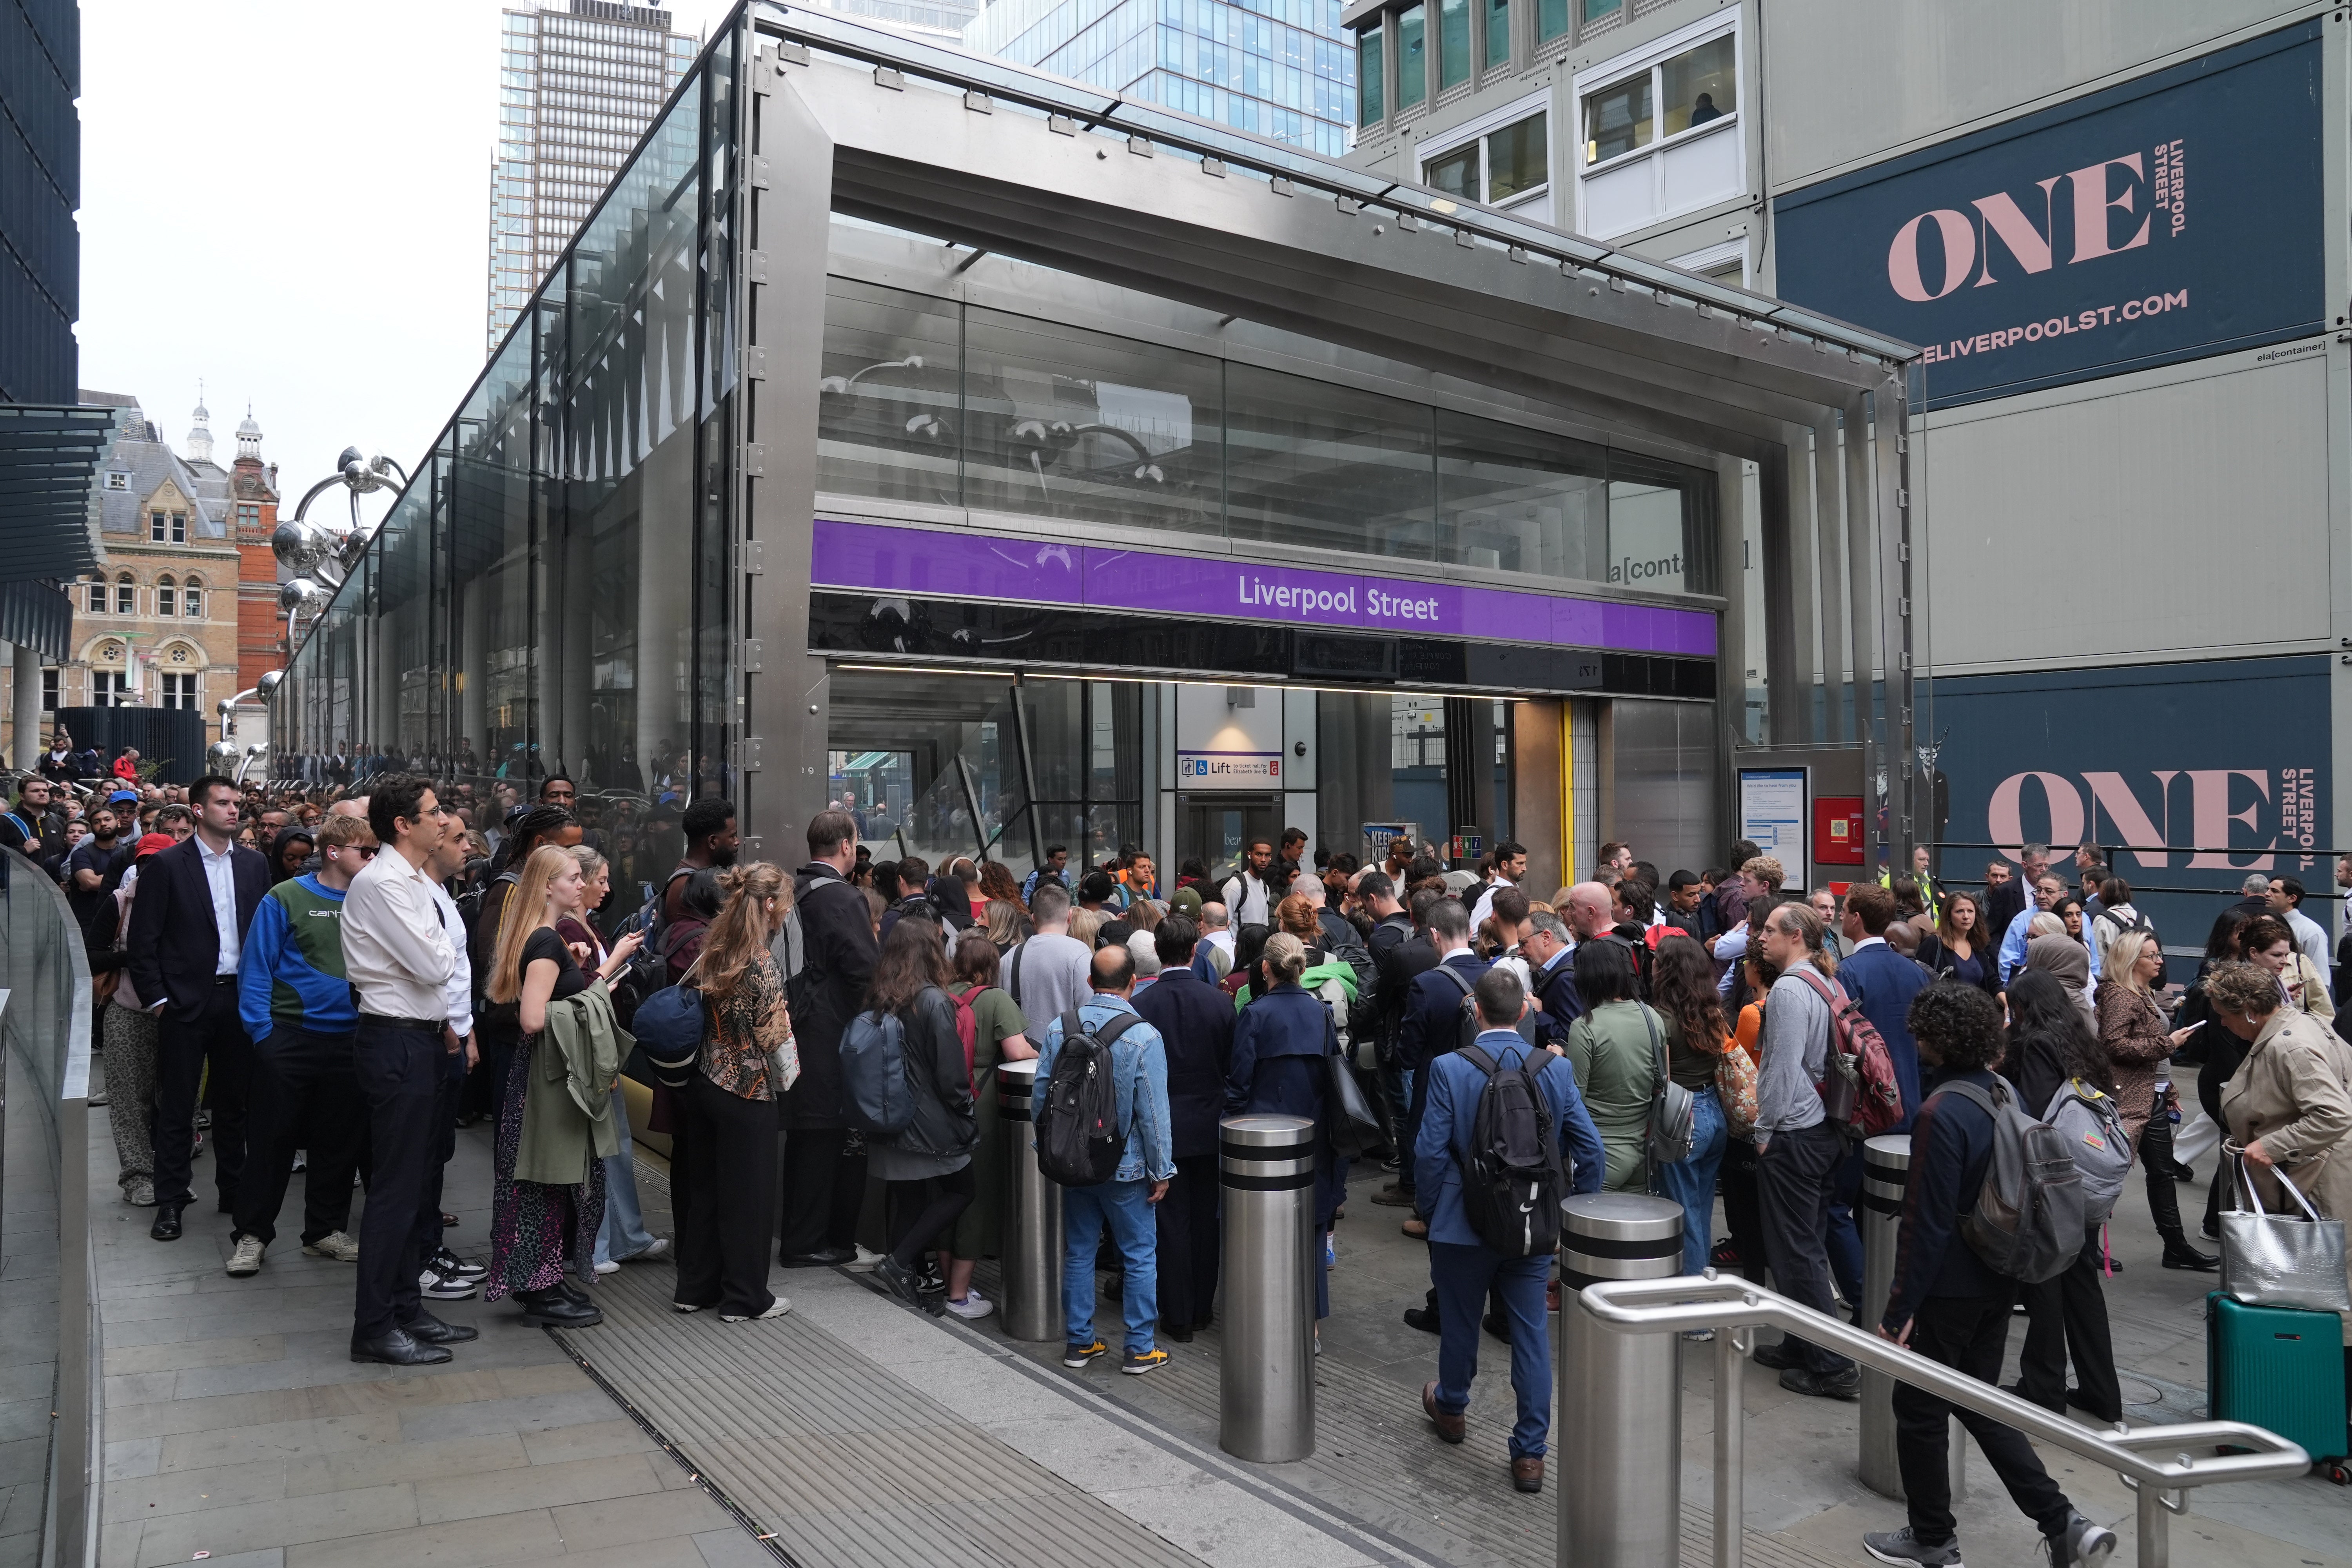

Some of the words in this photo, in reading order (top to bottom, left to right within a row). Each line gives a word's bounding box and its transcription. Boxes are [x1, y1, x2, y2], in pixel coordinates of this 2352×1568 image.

[1519, 64, 1551, 82] ela[container]
[2154, 144, 2169, 210] STREET
[2169, 138, 2186, 238] LIVERPOOL
[1888, 151, 2151, 302] ONE
[2257, 341, 2326, 361] ela[container]
[1611, 553, 1685, 585] a[cont
[1240, 576, 1357, 615] Liverpool
[1367, 588, 1439, 621] Street
[1212, 762, 1230, 773] Lift
[1271, 766, 1277, 774] G
[515, 805, 522, 814] P
[1988, 769, 2276, 870] ONE
[2282, 768, 2296, 838] STREET
[2299, 768, 2314, 871] LIVERPOOL
